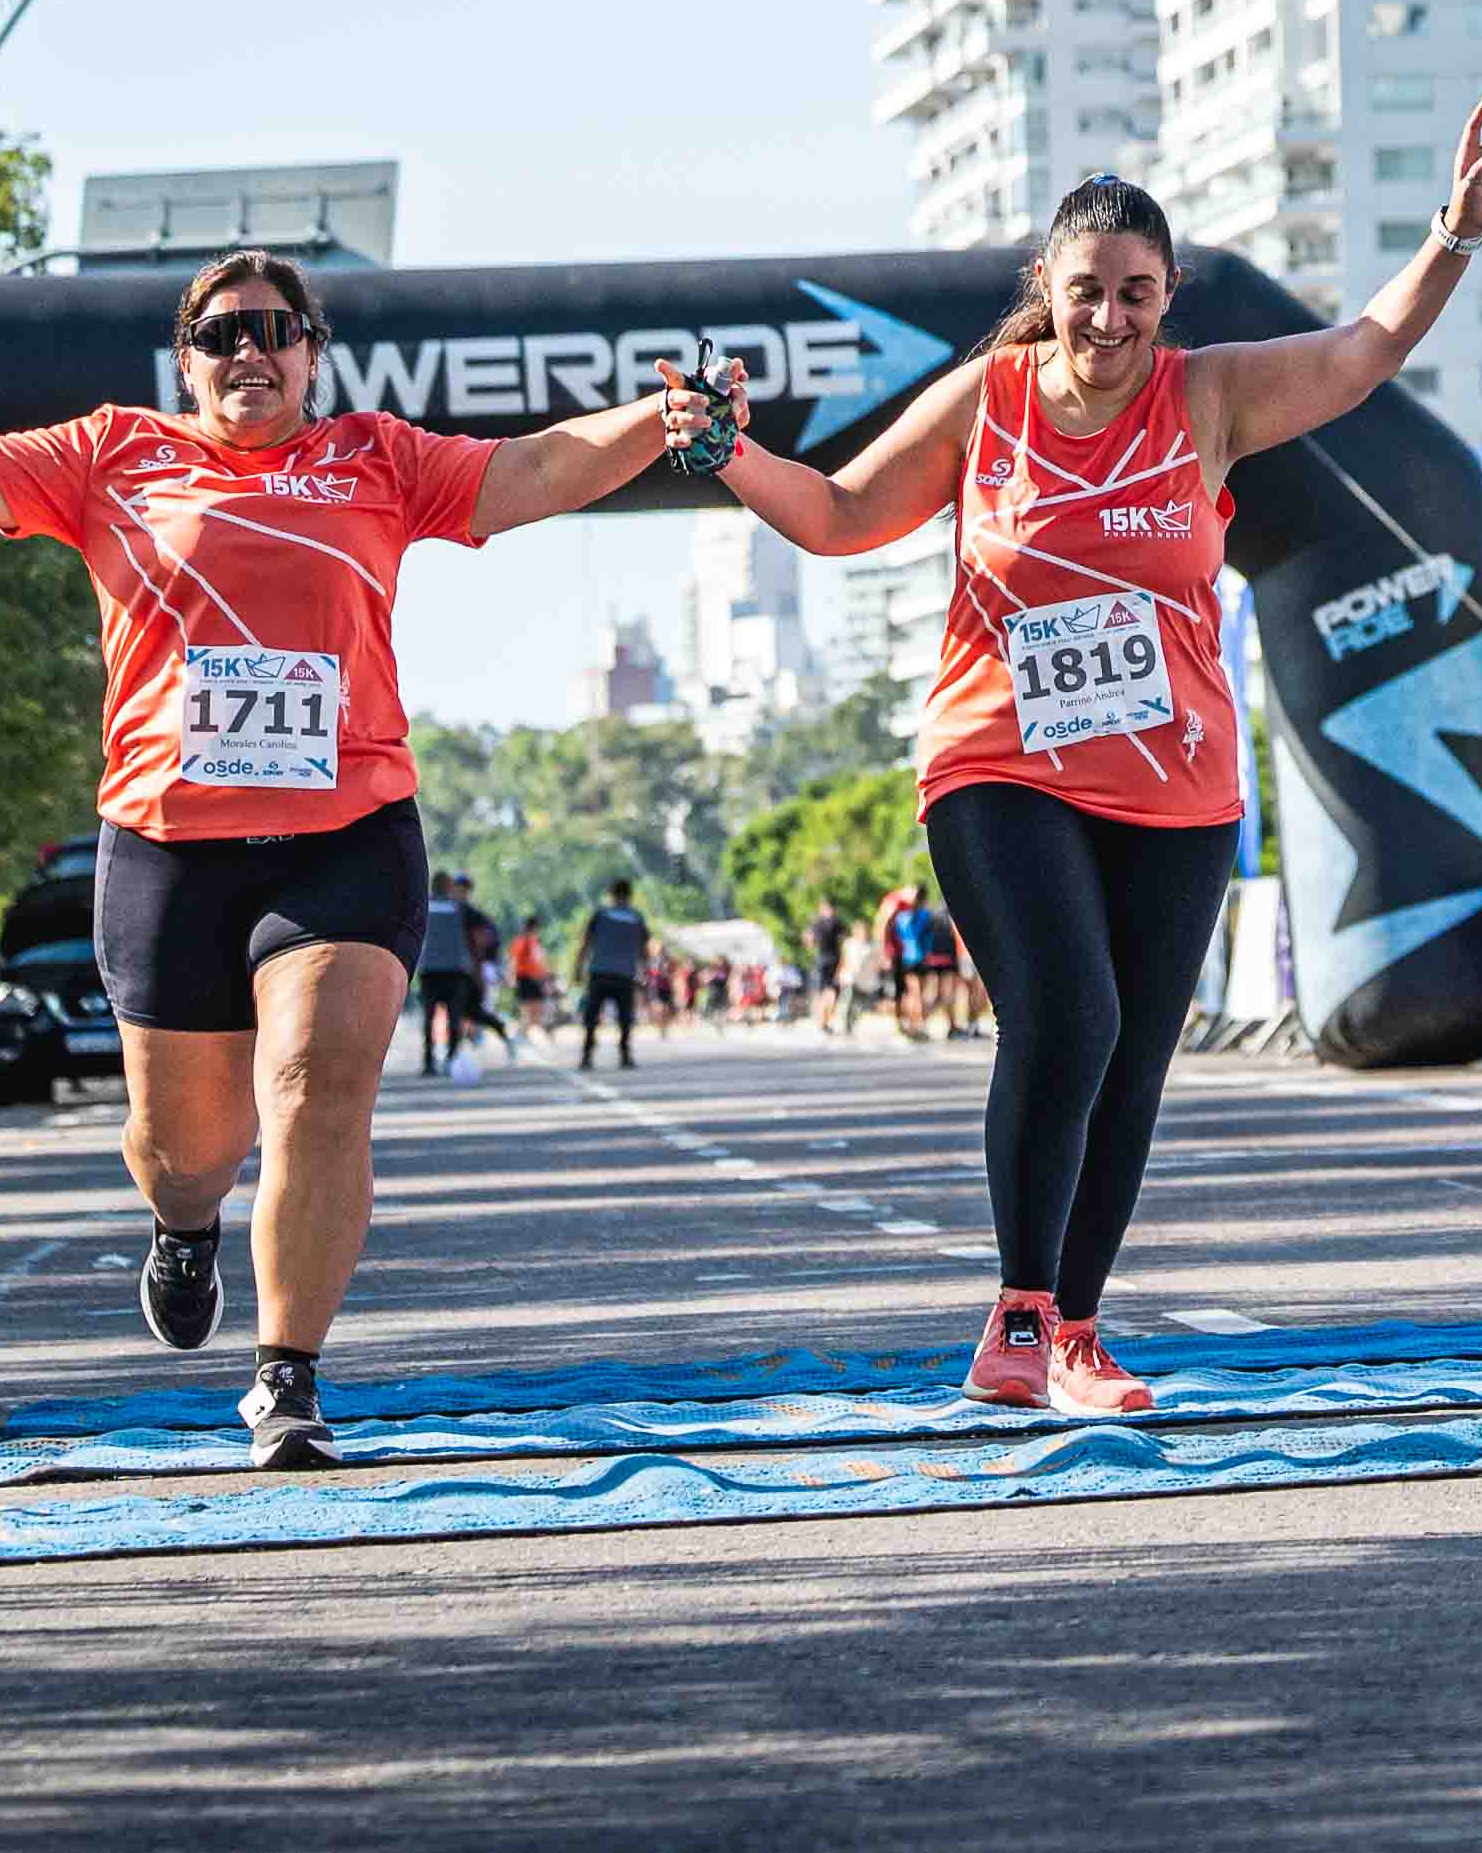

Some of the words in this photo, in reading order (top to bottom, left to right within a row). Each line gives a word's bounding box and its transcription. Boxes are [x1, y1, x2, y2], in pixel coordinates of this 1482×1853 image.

[154, 320, 868, 418] WERADE
[262, 475, 312, 496] 15K
[976, 473, 1012, 486] SOND
[1099, 506, 1151, 532] 15K
[1109, 609, 1133, 625] 15K
[1018, 616, 1062, 644] 15K
[200, 657, 241, 678] 15K
[293, 667, 315, 679] 15K
[1018, 633, 1157, 701] 1819
[189, 689, 329, 738] 1711
[1043, 715, 1093, 739] osde
[203, 759, 254, 778] osde
